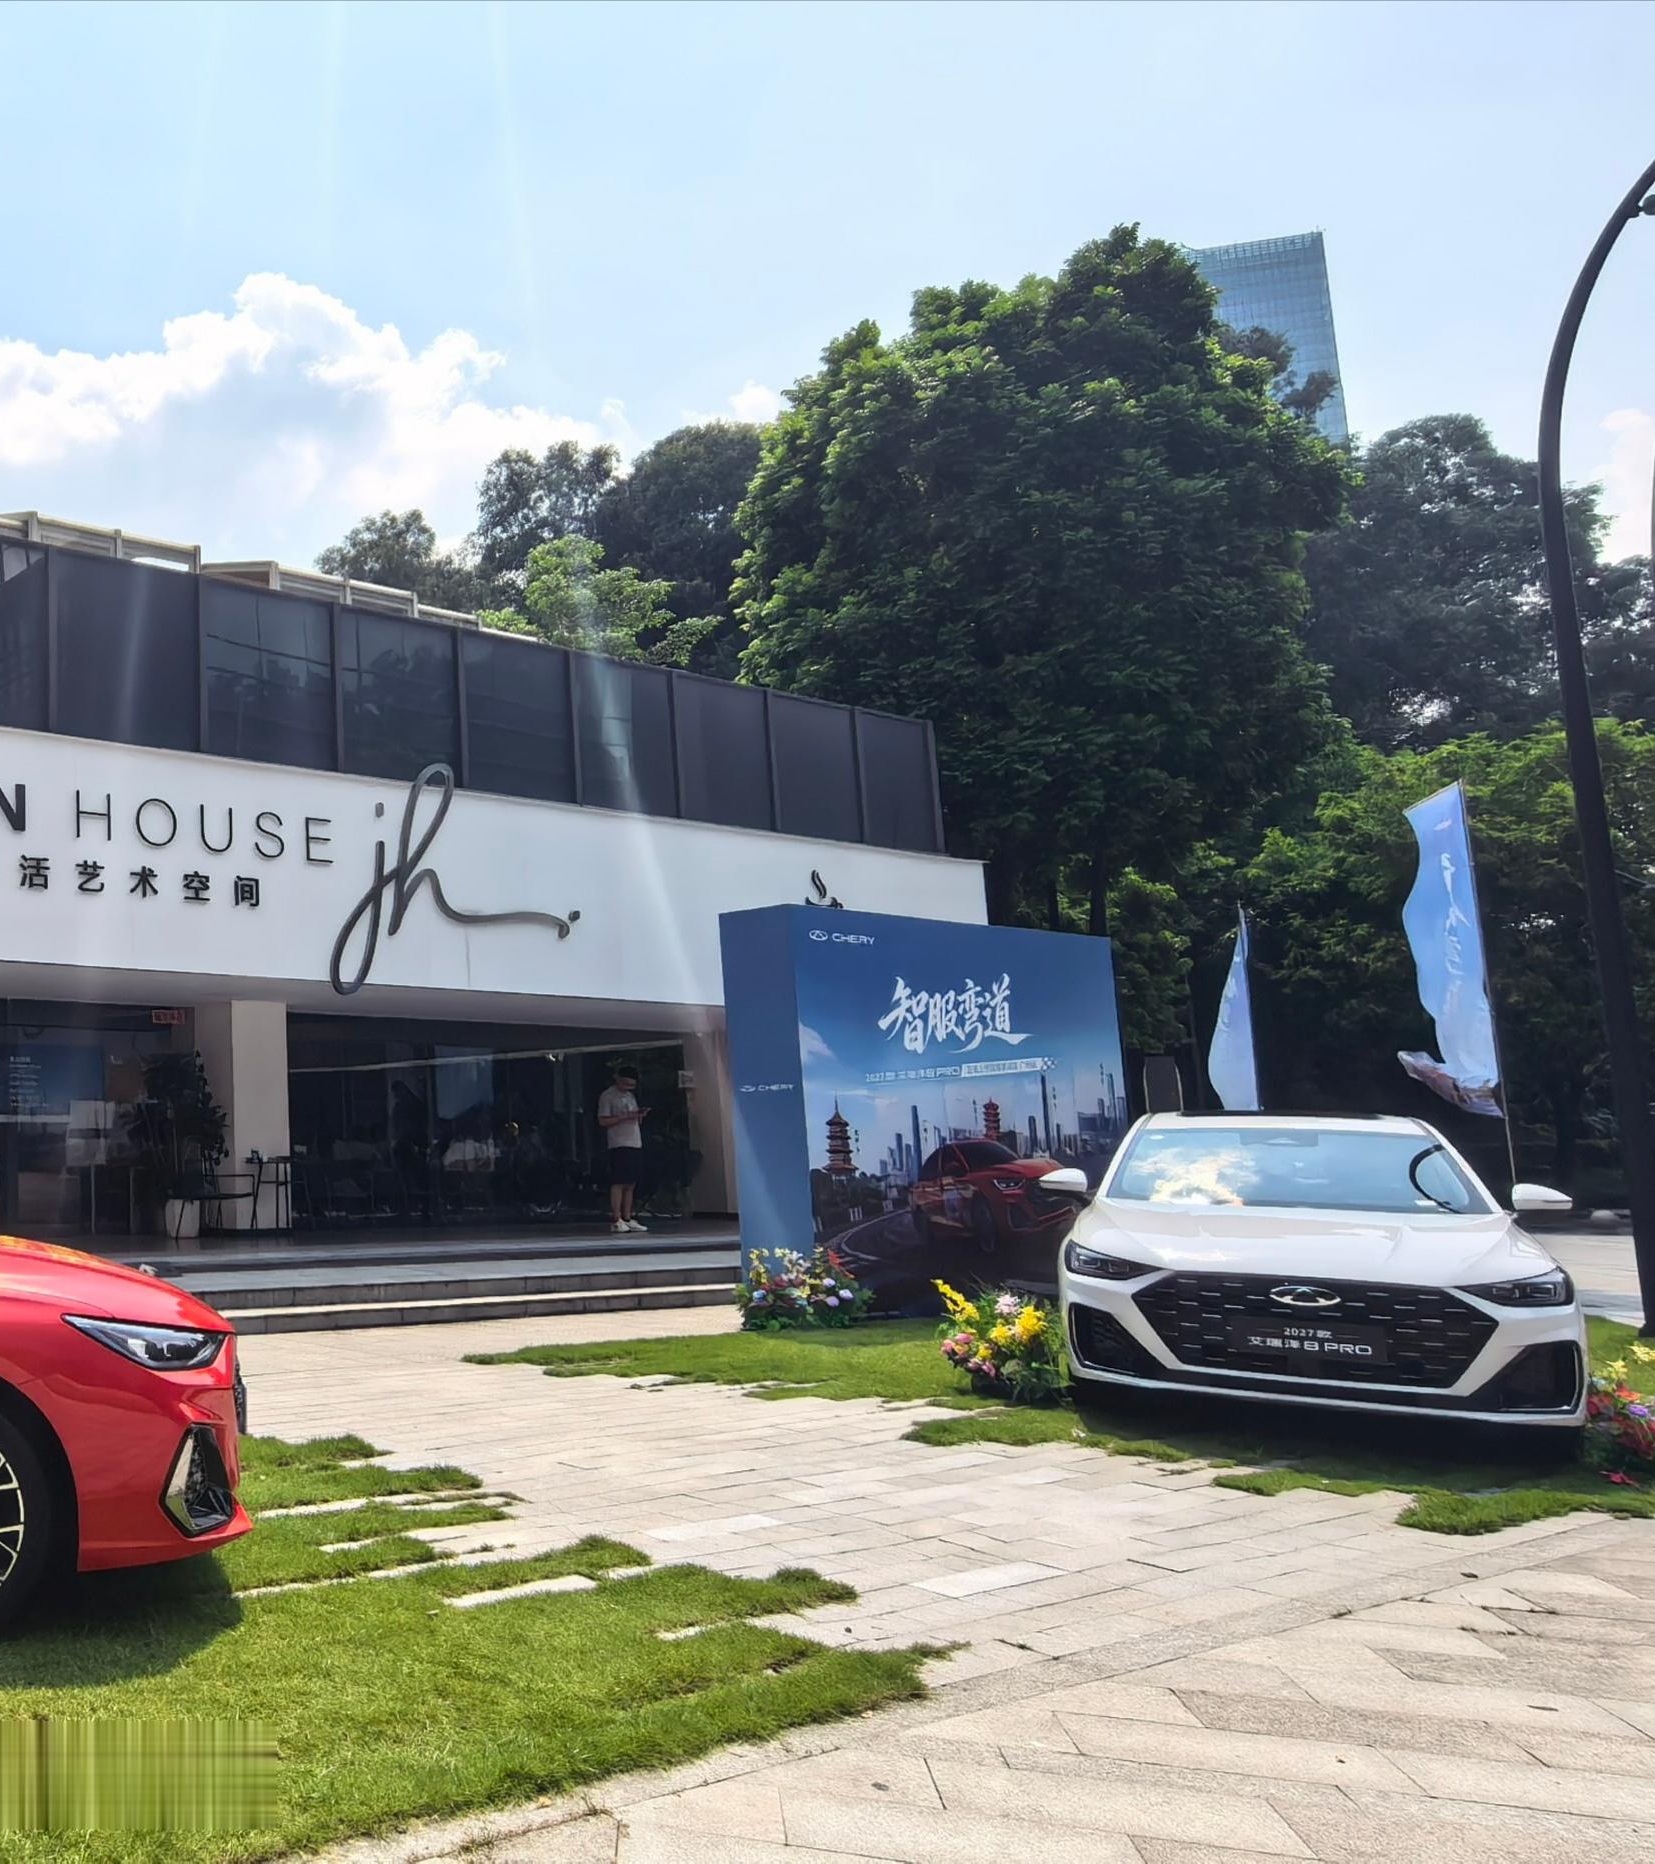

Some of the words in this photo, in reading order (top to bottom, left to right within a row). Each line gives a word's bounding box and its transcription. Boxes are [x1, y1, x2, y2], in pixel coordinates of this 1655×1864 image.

[75, 788, 334, 865] HOUSE
[831, 932, 875, 945] CHERY
[877, 972, 1037, 1054] 智服弯道
[936, 1066, 960, 1078] PRO
[1283, 1326, 1333, 1339] 2027款
[1247, 1336, 1319, 1351] 艾瑞泽8
[1324, 1342, 1373, 1356] PRO
